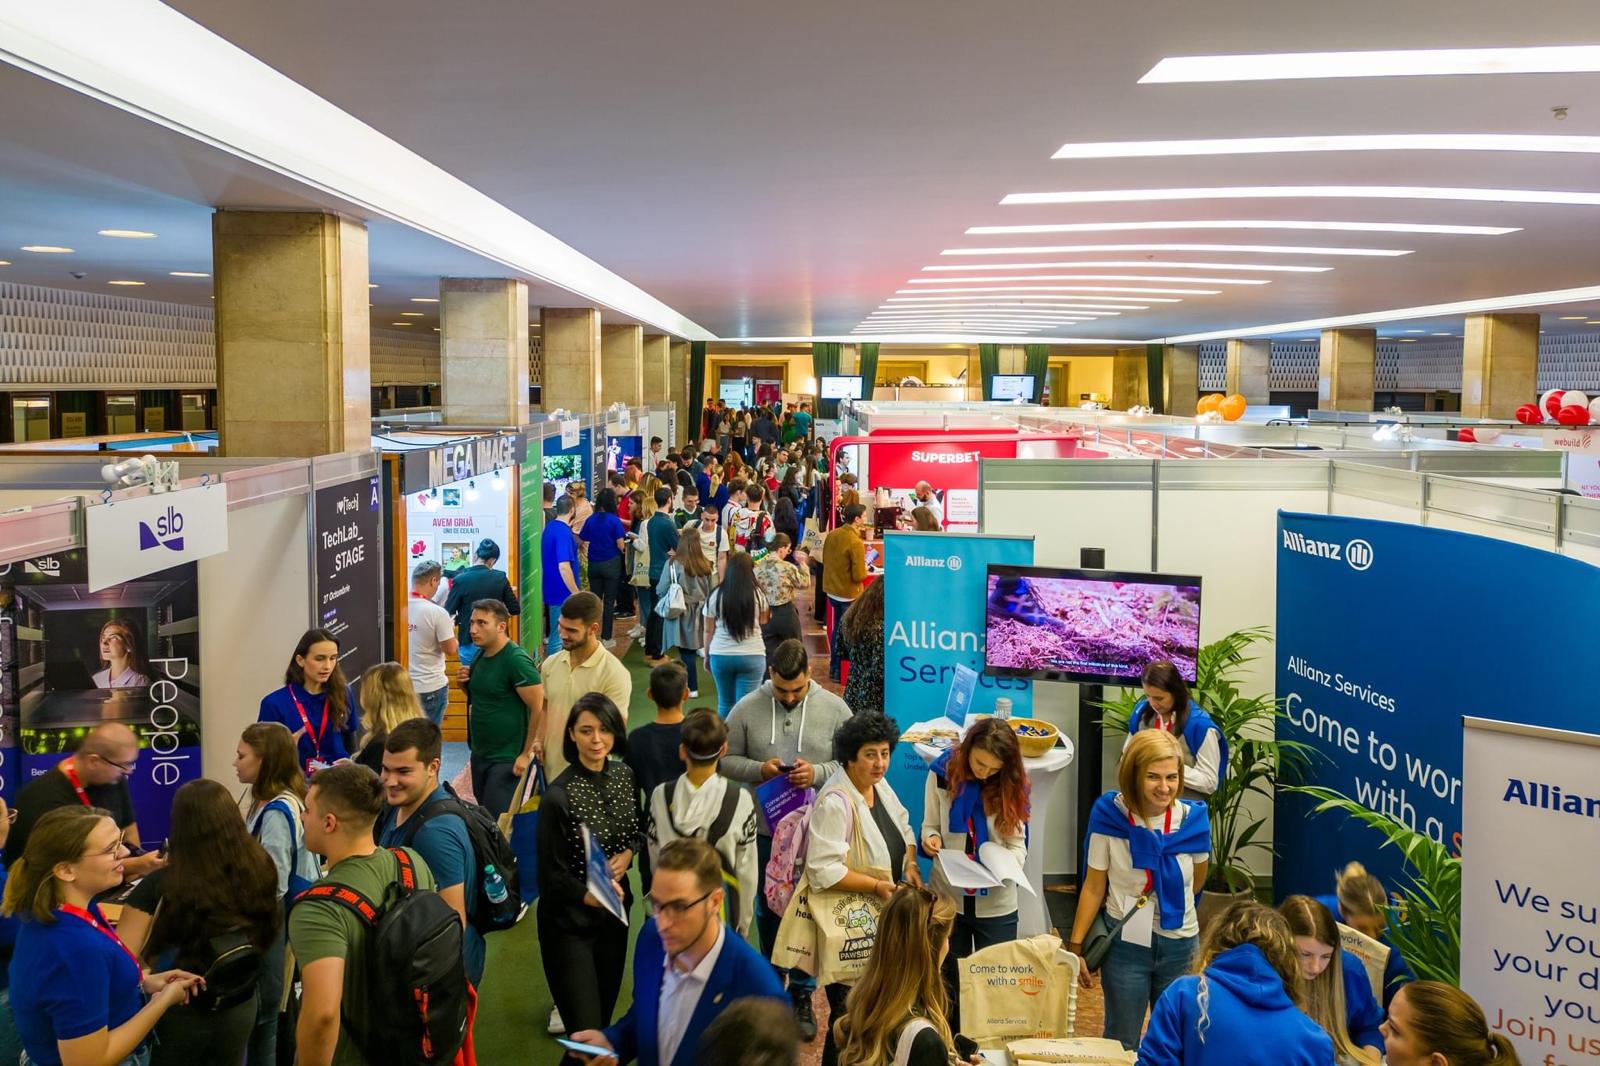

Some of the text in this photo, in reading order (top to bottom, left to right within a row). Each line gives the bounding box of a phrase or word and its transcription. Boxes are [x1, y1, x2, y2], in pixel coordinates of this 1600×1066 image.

[911, 451, 980, 464] SUPERBET
[1554, 439, 1581, 447] webuild
[428, 435, 516, 489] MEGA IMAGE
[371, 486, 378, 506] A
[157, 506, 184, 537] slb
[432, 518, 453, 527] AVEM
[1283, 529, 1342, 561] Allianz
[38, 557, 60, 570] slb
[905, 556, 945, 568] Allianz
[1287, 656, 1396, 713] Allianz Services
[141, 657, 189, 786] People
[1286, 692, 1360, 755] Come
[1368, 731, 1397, 771] to
[1355, 777, 1417, 833] with
[1495, 880, 1550, 913] We
[969, 964, 1033, 974] Come to work
[1494, 949, 1568, 982] your
[987, 976, 1045, 987] with a smile
[1492, 1008, 1556, 1046] Join
